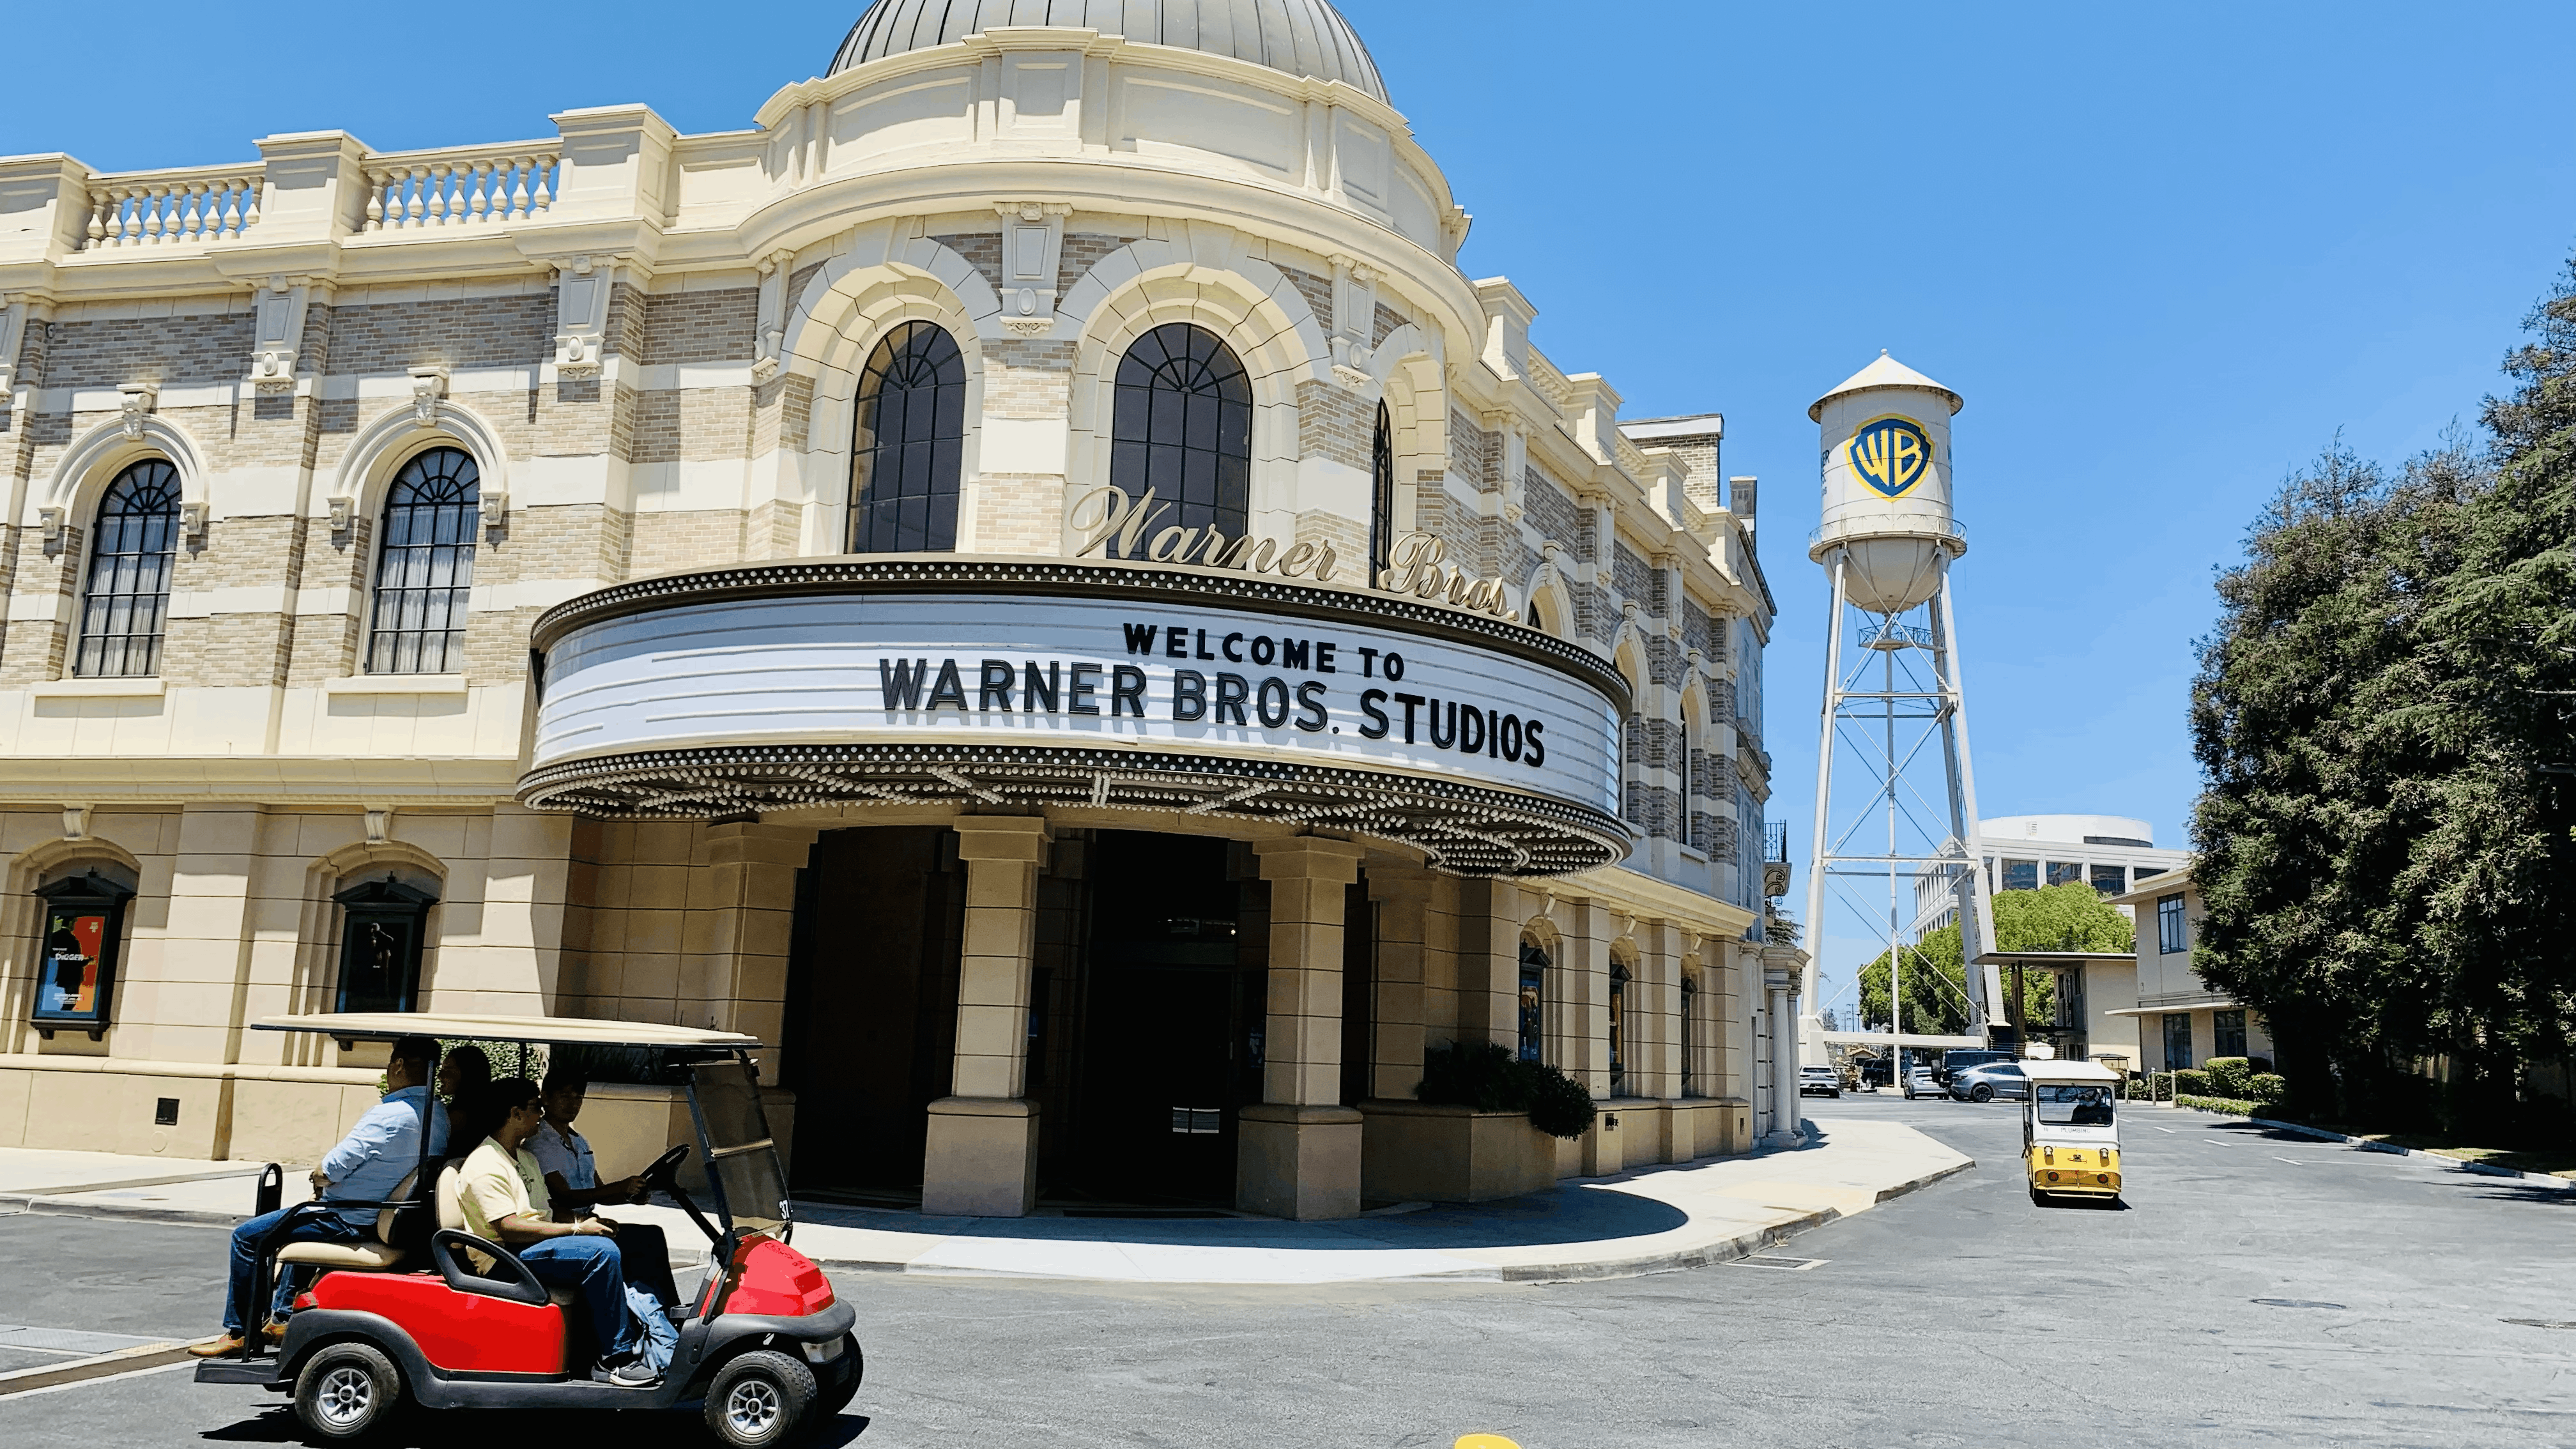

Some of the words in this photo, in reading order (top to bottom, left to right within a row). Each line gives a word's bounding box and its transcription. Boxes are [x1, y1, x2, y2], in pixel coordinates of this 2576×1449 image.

[1856, 428, 1923, 487] WB
[1070, 485, 1338, 582] Warner
[1379, 532, 1521, 621] Bros.
[1123, 623, 1337, 673] WELCOME
[1358, 648, 1405, 682] TO
[879, 658, 1147, 717] WARNER
[1173, 669, 1340, 734] BROS.
[1359, 689, 1546, 768] STUDIOS
[779, 1199, 790, 1220] 37
